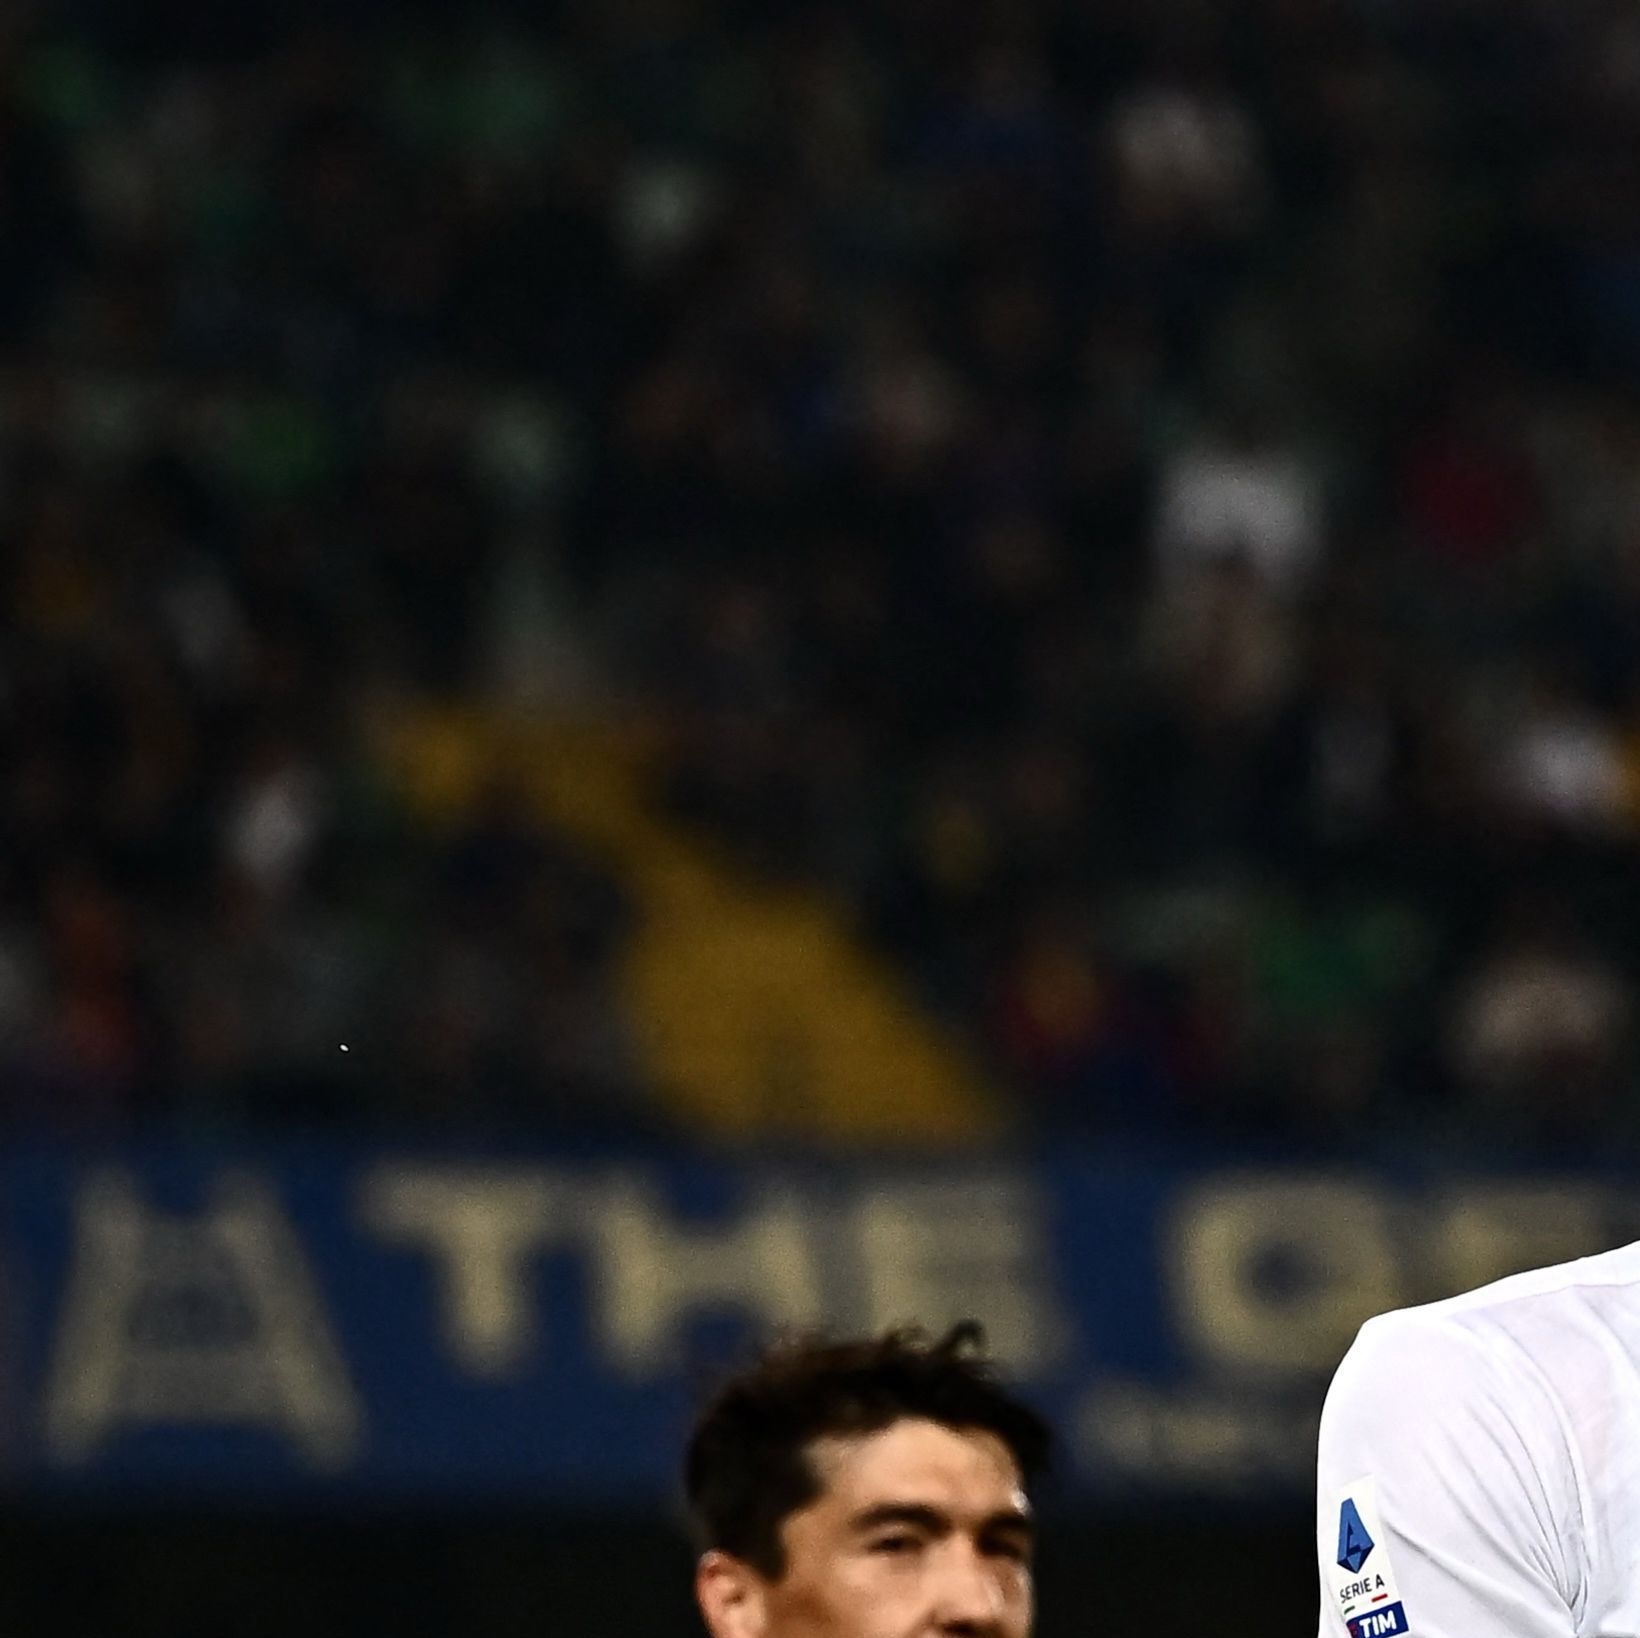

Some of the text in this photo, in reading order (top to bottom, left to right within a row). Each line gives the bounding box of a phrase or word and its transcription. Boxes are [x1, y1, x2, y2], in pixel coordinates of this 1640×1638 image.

[1340, 1573, 1385, 1603] SERIE A
[1359, 1610, 1396, 1638] TIM
